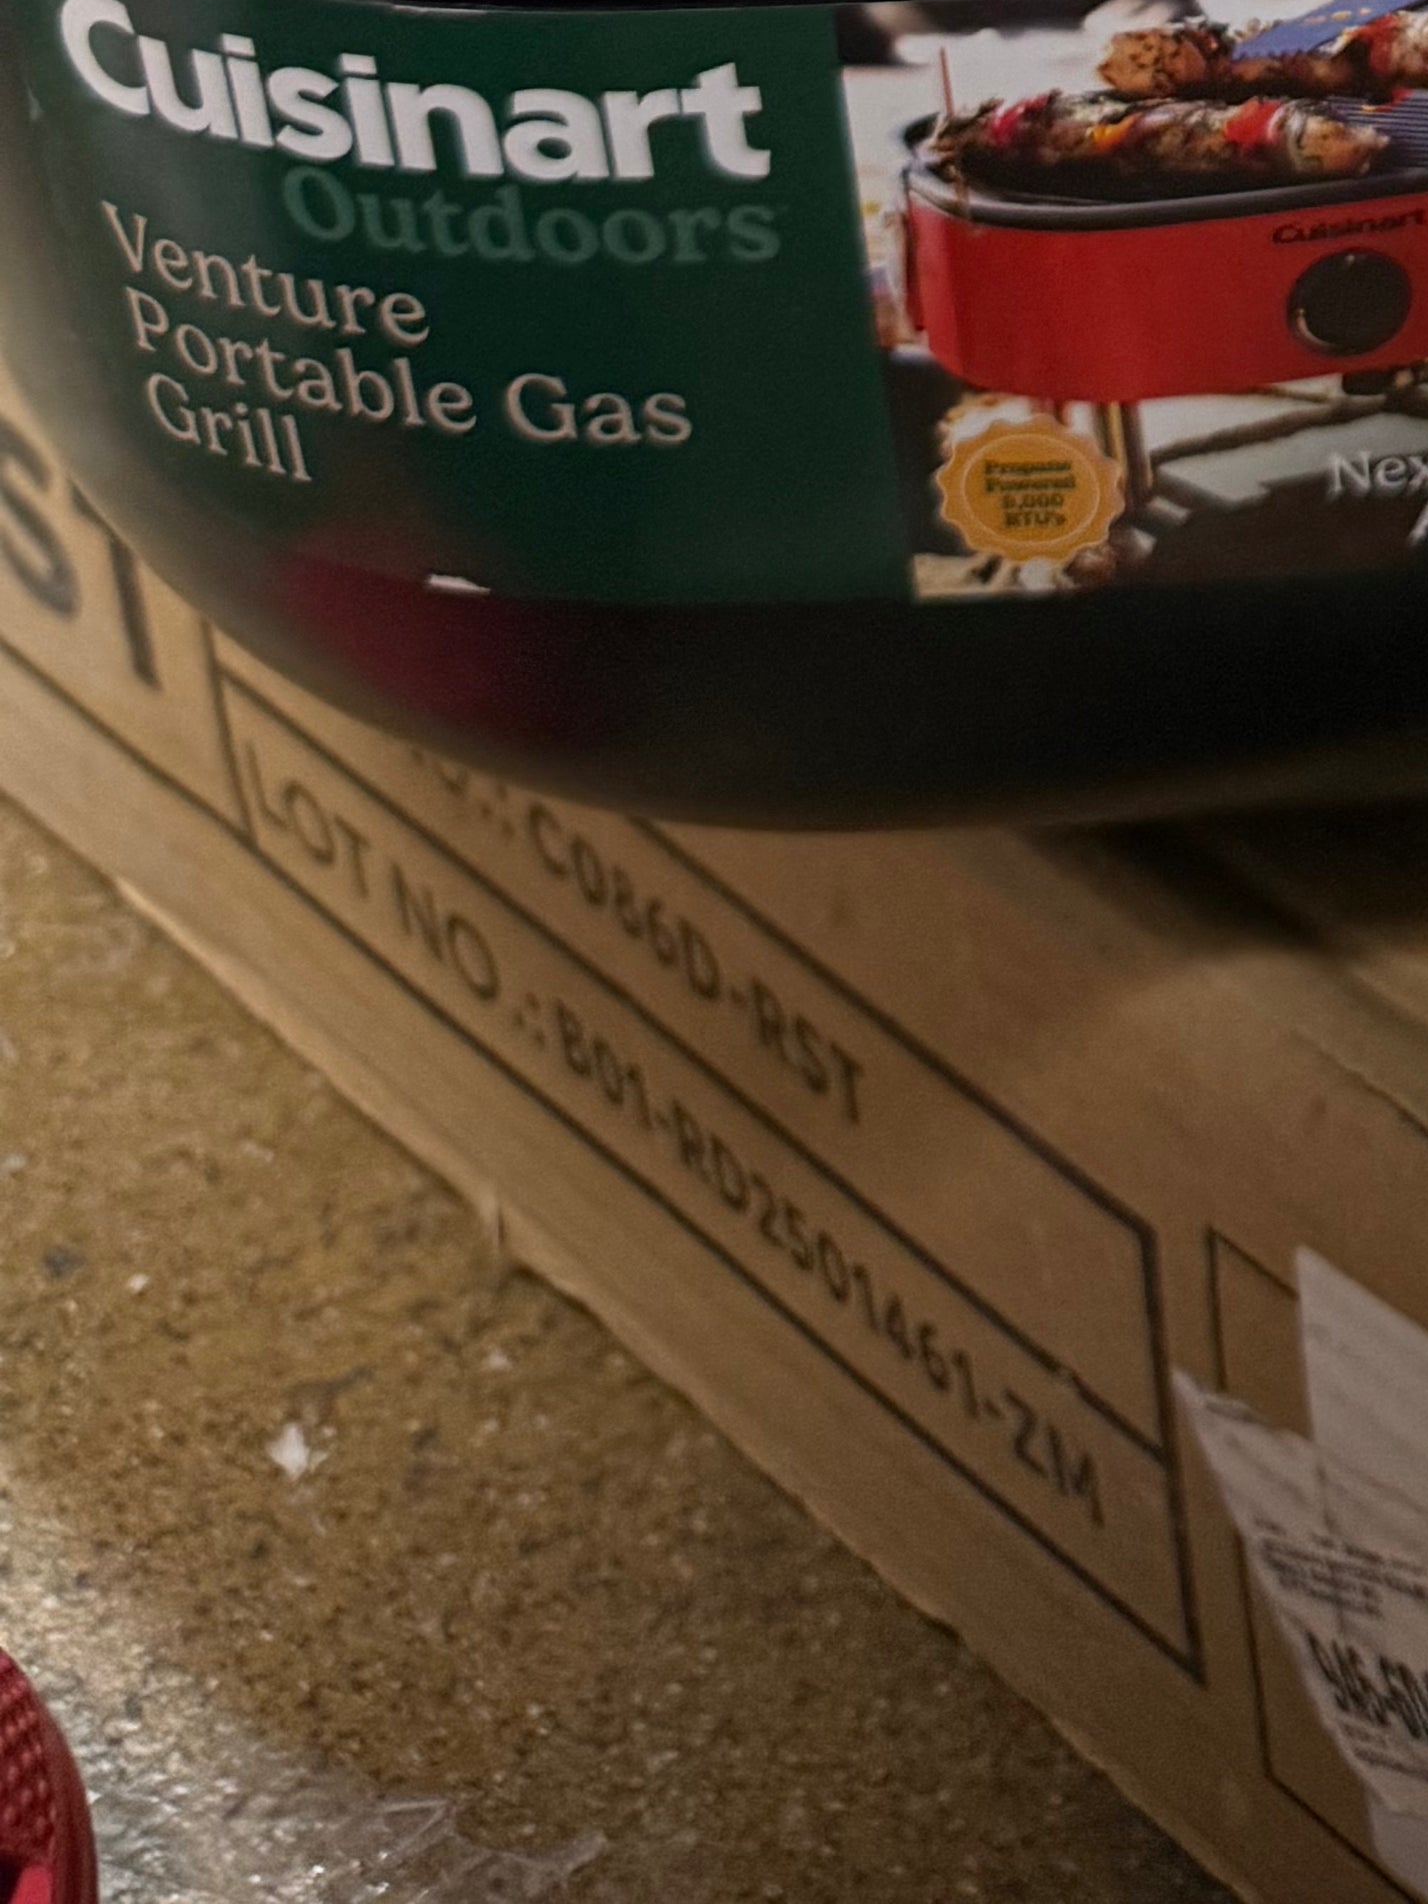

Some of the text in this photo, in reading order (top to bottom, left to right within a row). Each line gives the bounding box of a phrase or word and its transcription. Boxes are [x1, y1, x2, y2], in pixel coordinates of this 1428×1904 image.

[101, 198, 431, 346] Venture
[280, 167, 784, 264] Outdoors
[125, 285, 693, 446] Portable Gas
[145, 371, 312, 482] Grill
[245, 740, 373, 901] LOT
[526, 800, 864, 1128] C086D-RST
